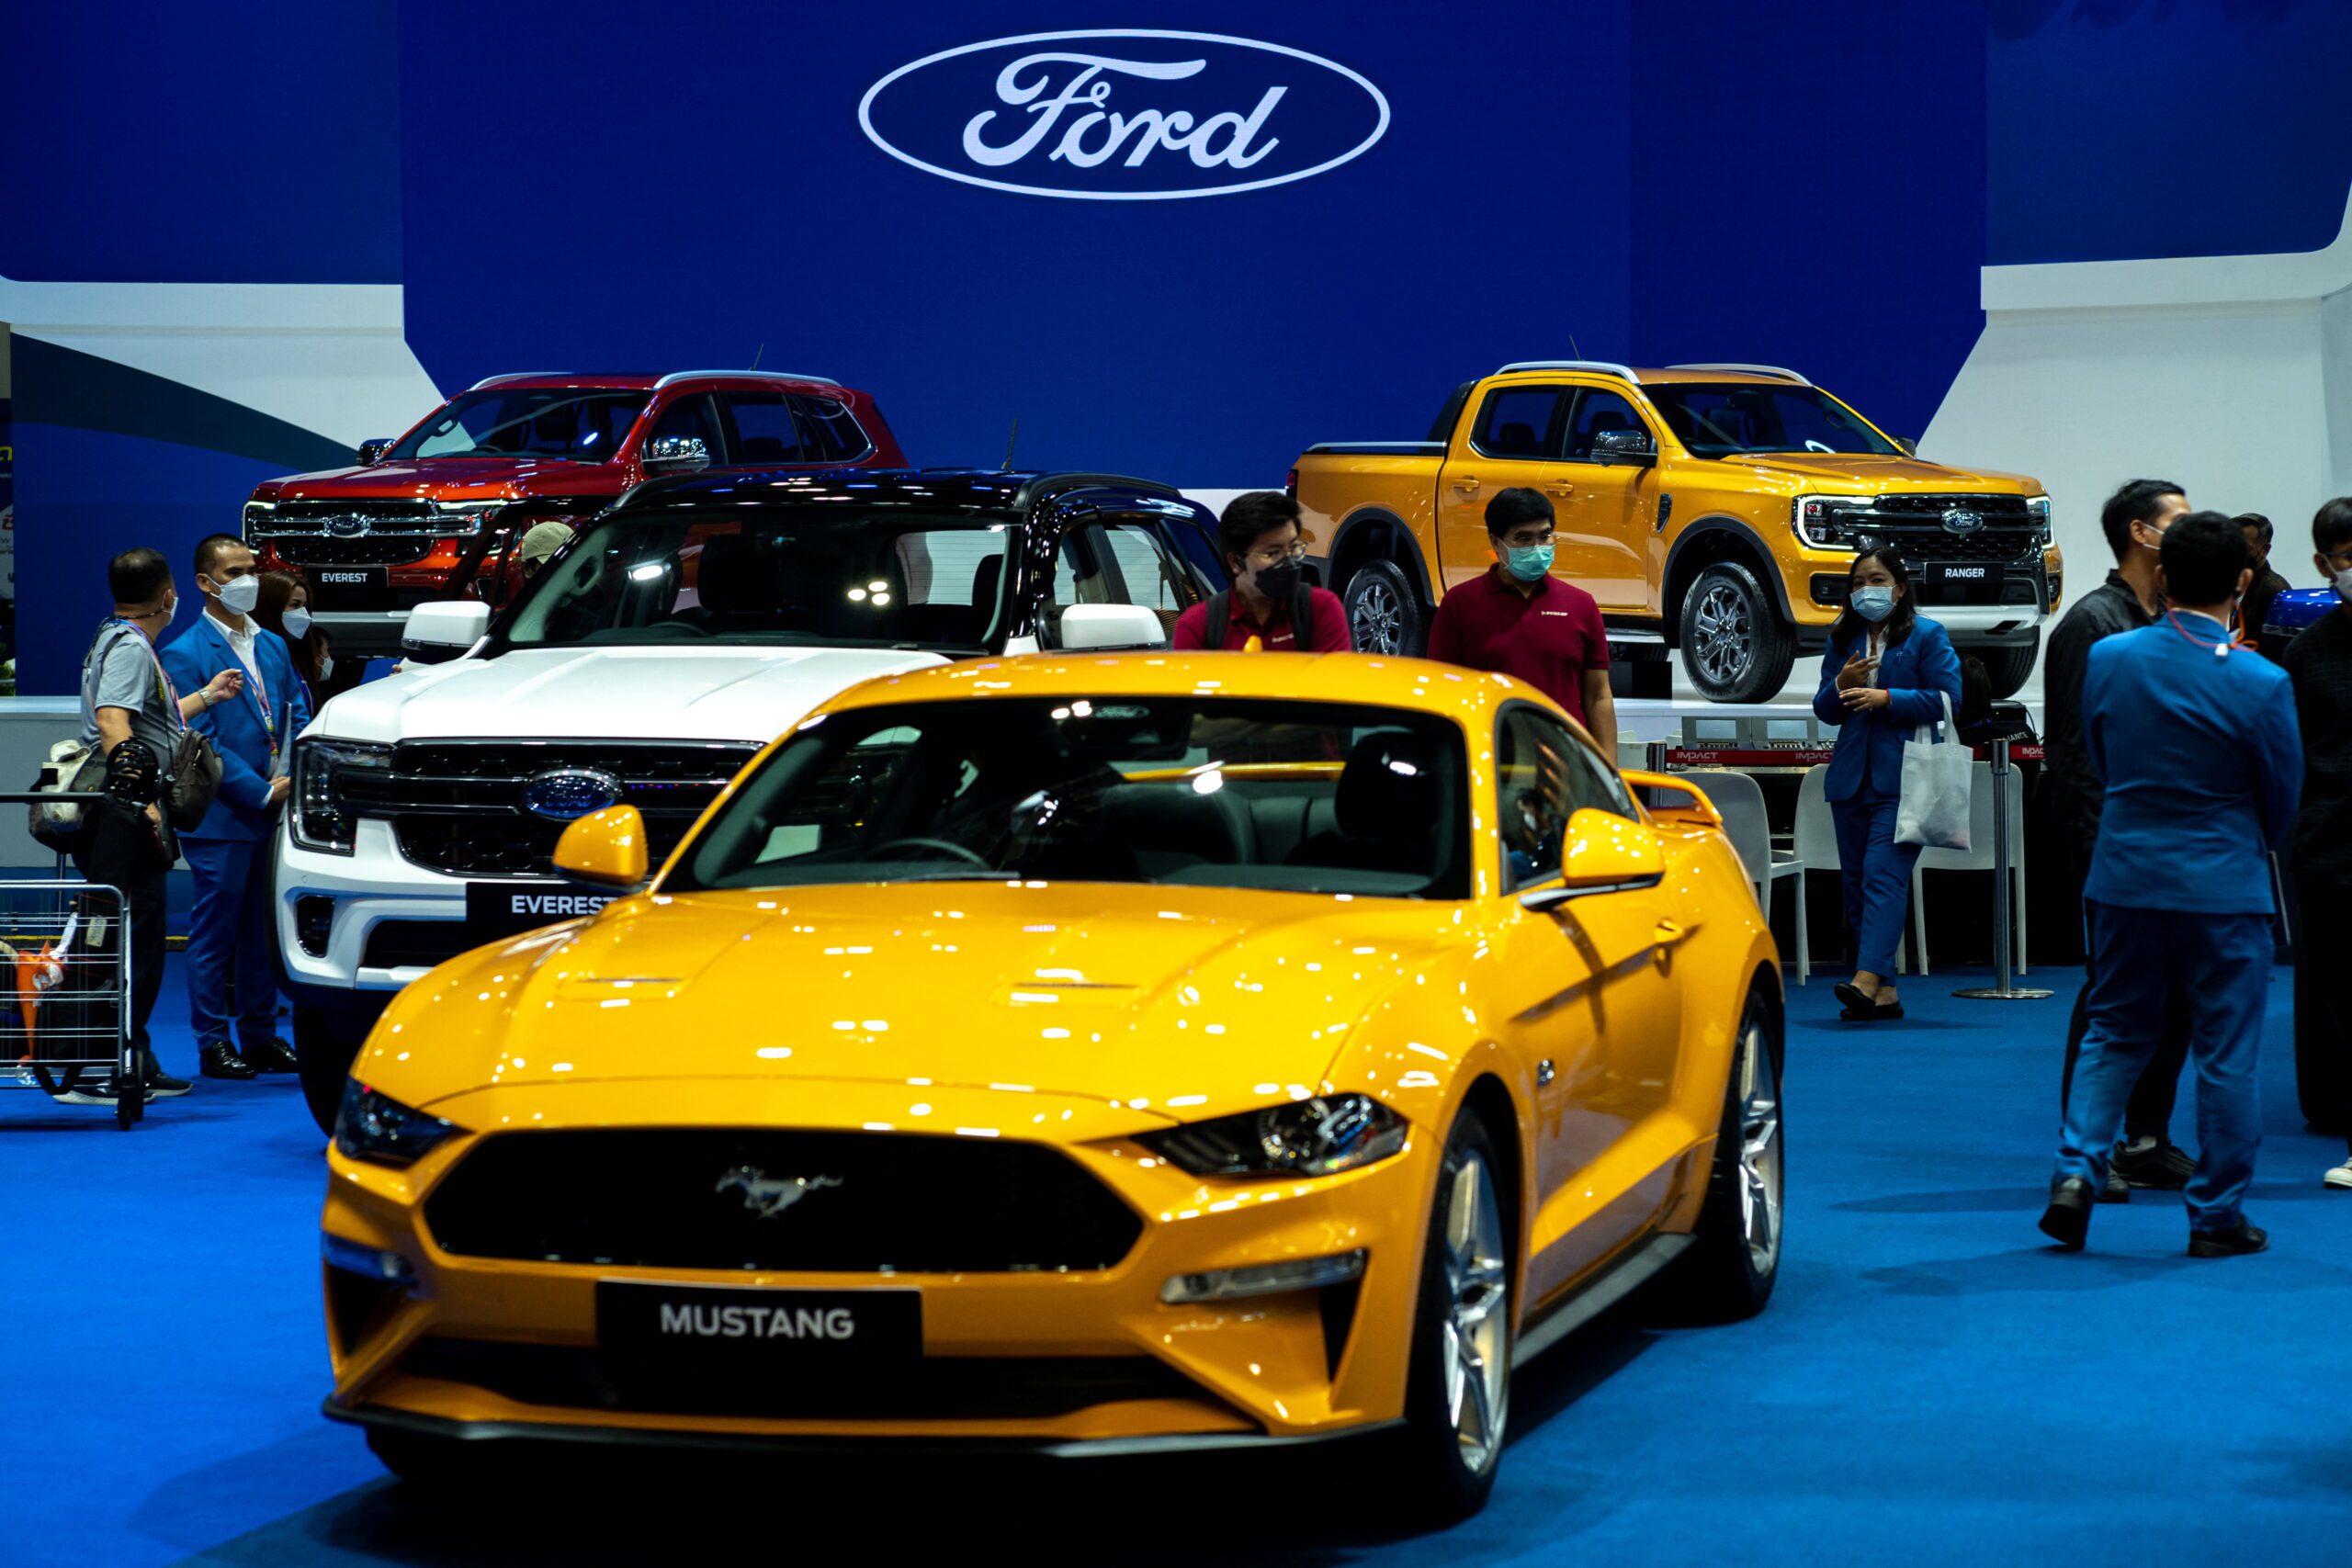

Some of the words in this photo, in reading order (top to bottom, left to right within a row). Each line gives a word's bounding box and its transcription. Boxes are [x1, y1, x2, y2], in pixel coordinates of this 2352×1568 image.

[963, 52, 1288, 169] Ford
[322, 572, 368, 582] EVEREST
[1945, 568, 1984, 578] RANGER
[1677, 751, 1718, 761] IMPACT
[2022, 747, 2044, 757] IMPAC
[660, 1303, 854, 1339] MUSTANG
